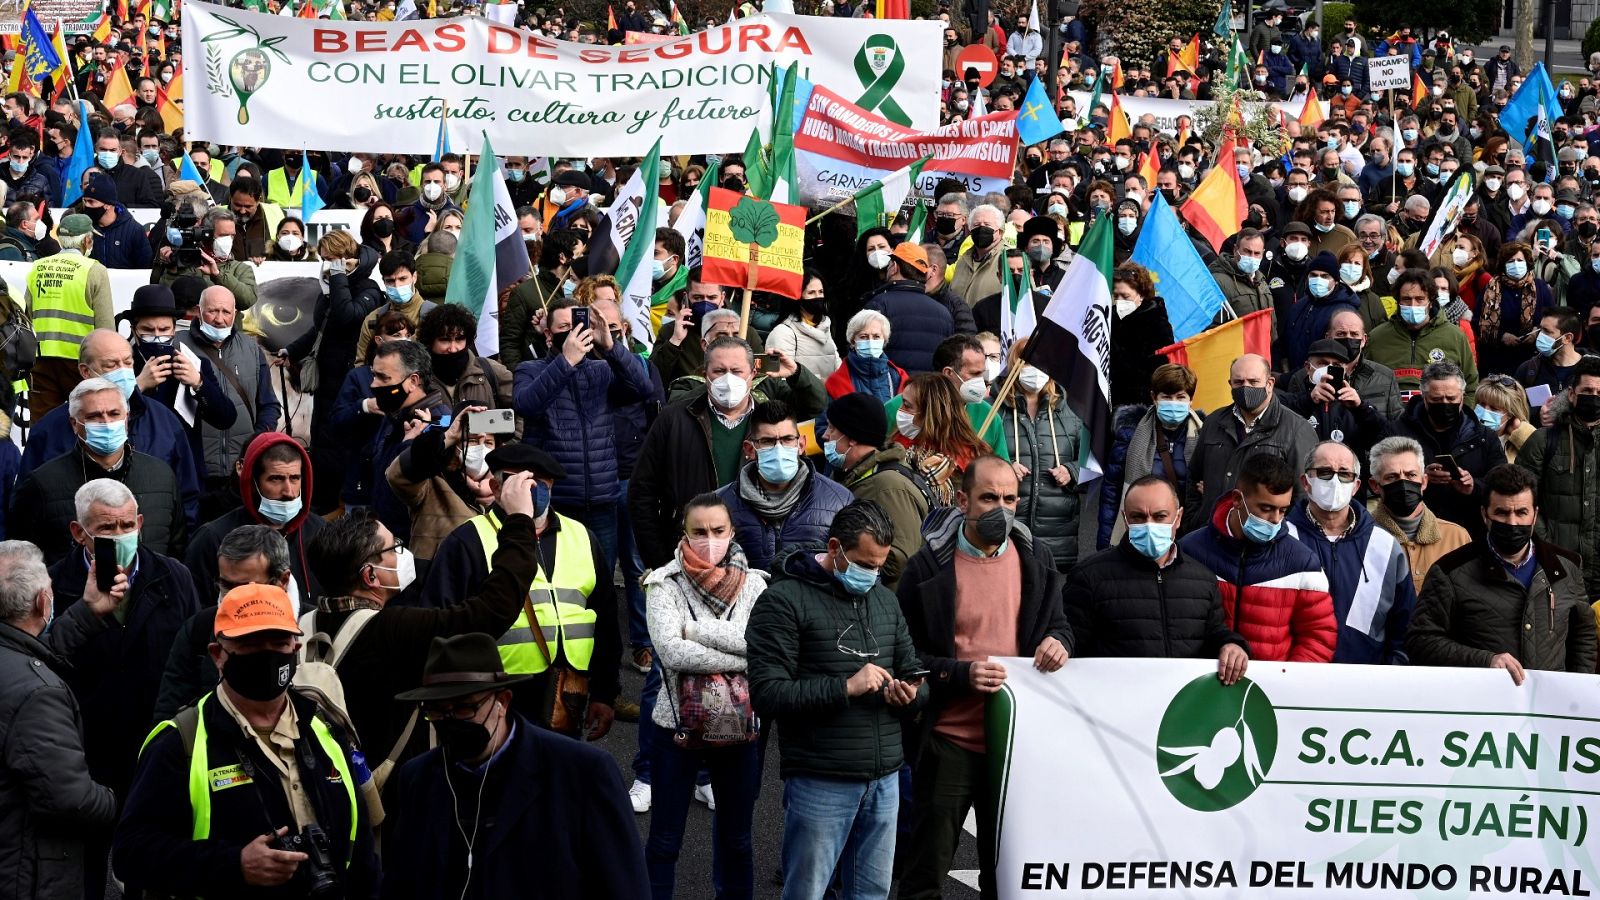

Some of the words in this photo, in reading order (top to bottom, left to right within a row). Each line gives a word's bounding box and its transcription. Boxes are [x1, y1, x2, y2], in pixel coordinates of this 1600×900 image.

[313, 23, 466, 53] BEAS
[487, 25, 558, 60] DE
[578, 24, 813, 64] SEGURA
[307, 61, 385, 84] CON
[399, 63, 441, 85] EL
[451, 63, 578, 92] OLIVAR
[587, 63, 810, 92] TRADICIONL
[1371, 79, 1387, 87] HAY
[1382, 68, 1394, 76] NO
[506, 101, 626, 124] cultura
[626, 109, 658, 134] y
[659, 96, 761, 129] futuro
[809, 93, 831, 114] SIN
[827, 102, 893, 138] GANADEROS
[962, 120, 978, 138] NO
[802, 117, 834, 142] HUGO
[868, 139, 918, 159] TRAIDOR
[56, 265, 76, 273] OLIVAR
[705, 244, 741, 259] MORAL
[749, 251, 759, 262] DE
[42, 279, 63, 288] JUSTOS
[1297, 726, 1424, 768] S.C.A.
[1440, 730, 1539, 770] SAN
[1558, 735, 1600, 775] IS
[1305, 798, 1422, 835] SILES
[1437, 794, 1587, 847] (JAÉN)
[1021, 863, 1070, 890] EN
[1081, 860, 1237, 890] DEFENSA
[1248, 861, 1314, 889] DEL
[1324, 862, 1459, 892] MUNDO
[1470, 866, 1591, 898] RURAL
